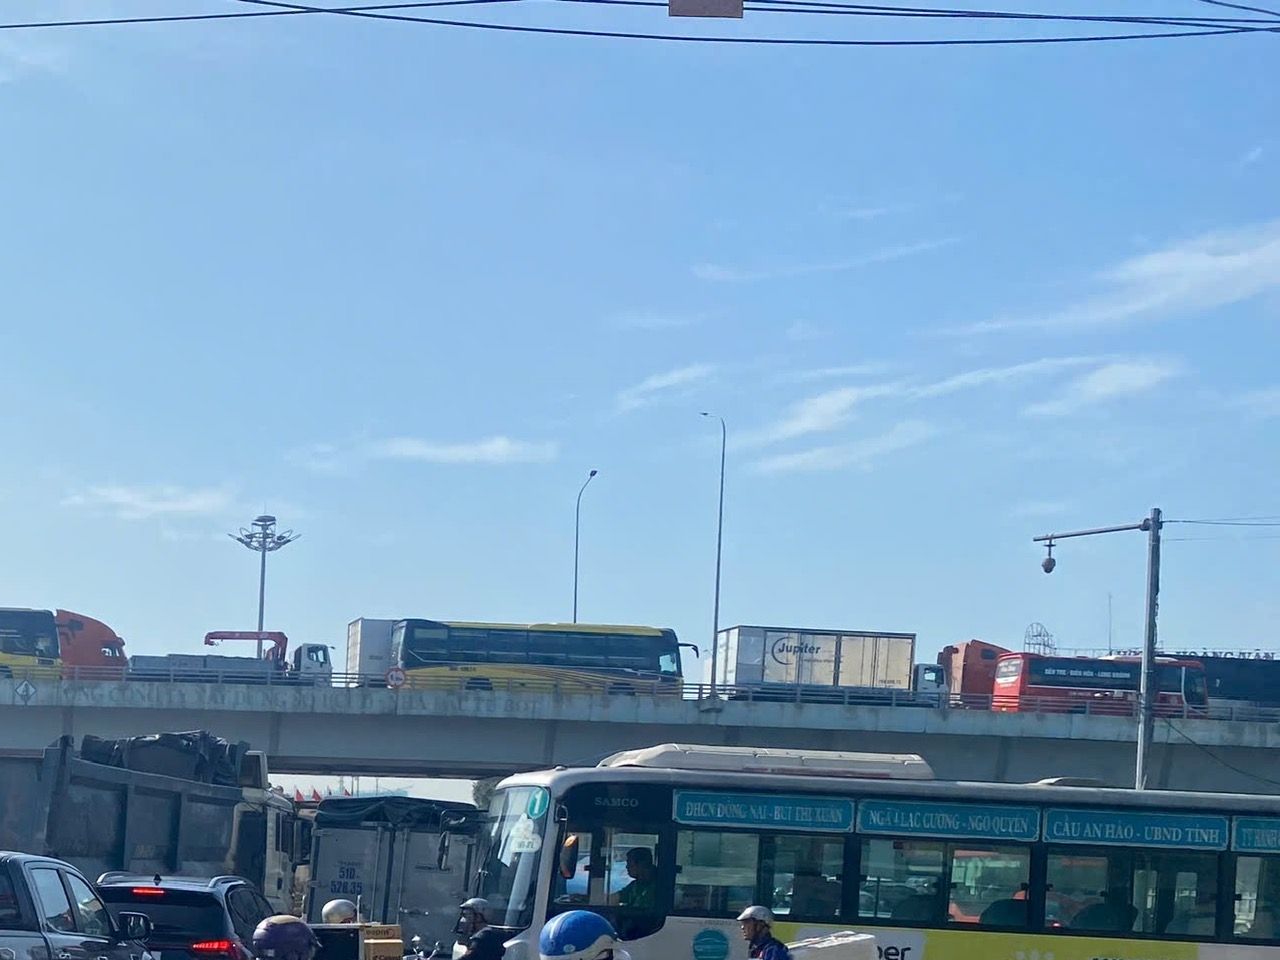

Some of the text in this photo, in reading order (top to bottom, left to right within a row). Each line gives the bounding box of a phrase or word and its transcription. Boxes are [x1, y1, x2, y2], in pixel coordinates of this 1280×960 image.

[778, 643, 821, 655] Jupiter
[533, 786, 543, 814] 1
[594, 796, 639, 808] SAMCO
[1083, 823, 1103, 838] AN
[1144, 827, 1182, 842] UBND
